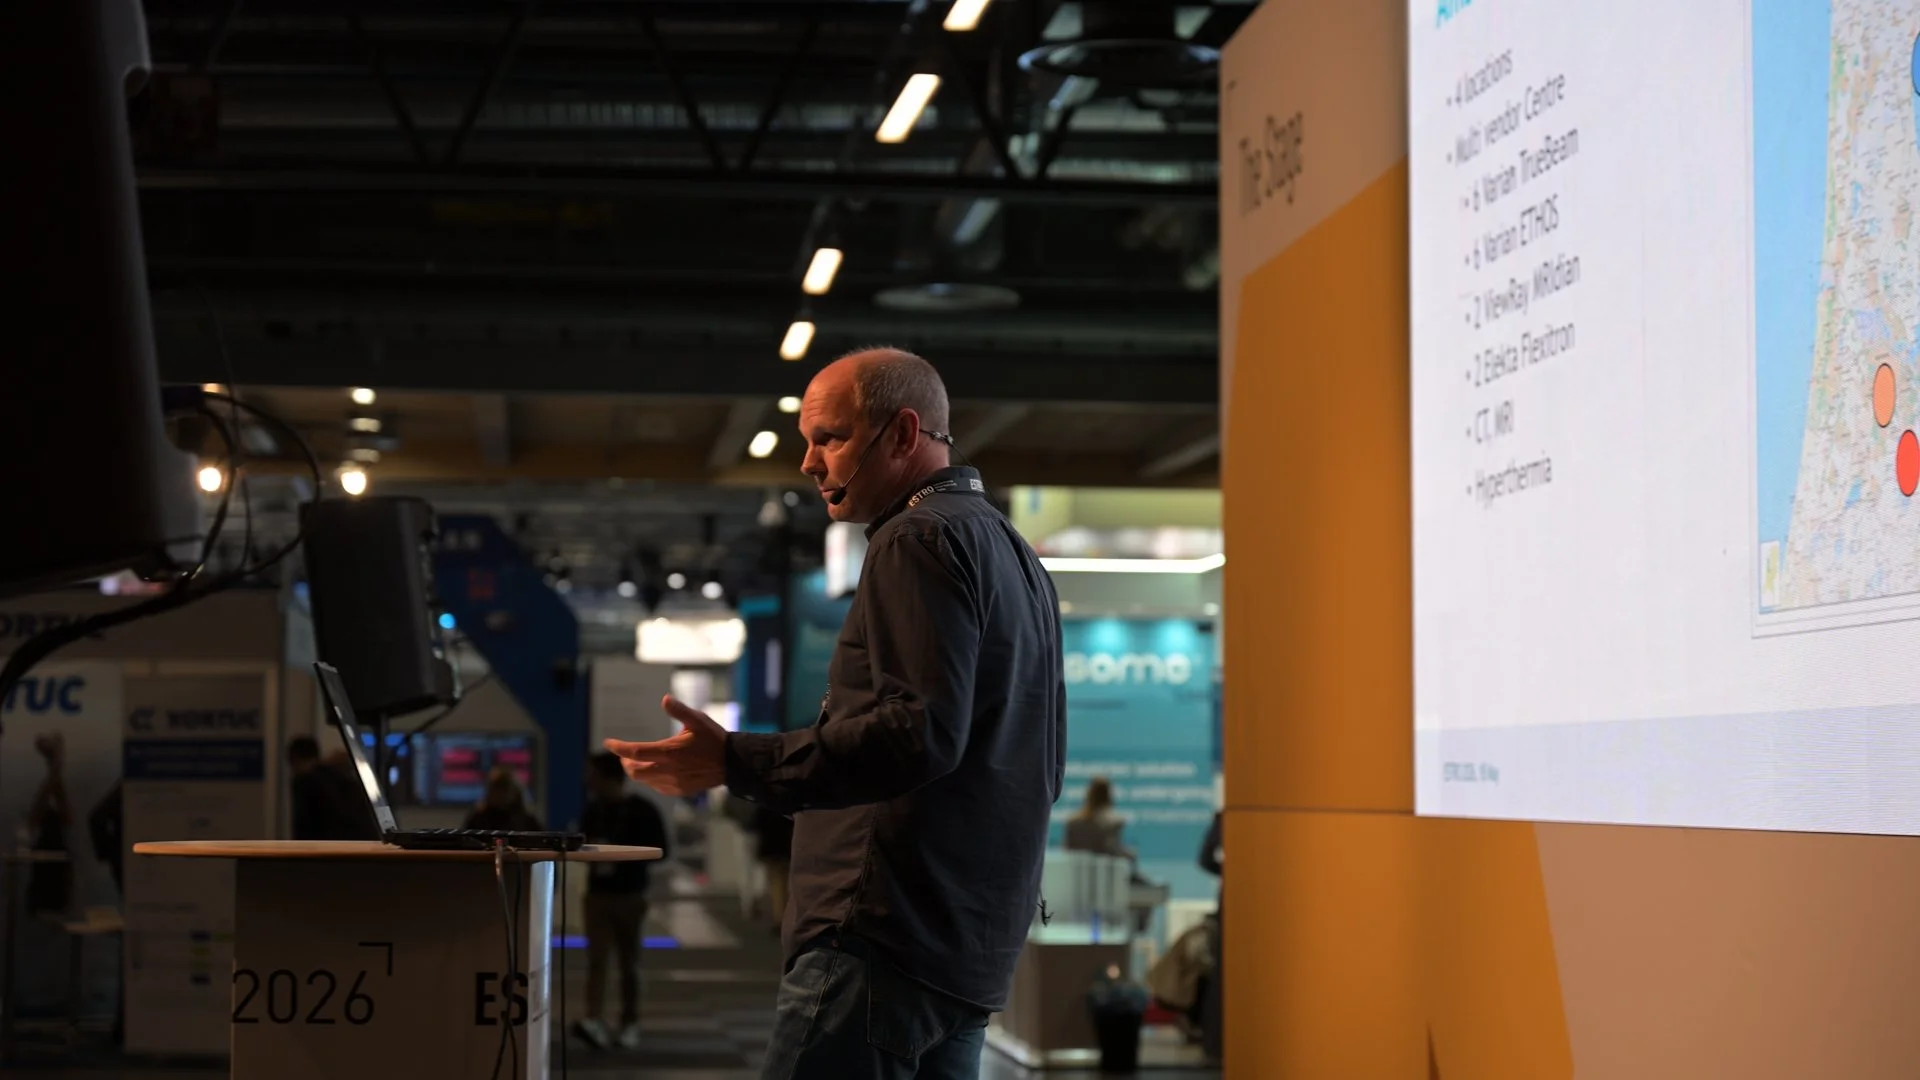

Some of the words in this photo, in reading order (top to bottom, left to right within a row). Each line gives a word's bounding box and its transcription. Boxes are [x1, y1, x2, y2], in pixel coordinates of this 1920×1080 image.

[1455, 79, 1462, 108] 4
[1464, 48, 1512, 103] locations
[1455, 121, 1481, 167] Multi
[1484, 100, 1522, 147] vendor
[1525, 73, 1565, 121] Centre
[1239, 135, 1262, 219] The
[1264, 112, 1304, 207] Stage
[1473, 178, 1480, 212] 6
[1482, 164, 1517, 205] Varian
[1519, 127, 1579, 184] TrueBeam
[1482, 223, 1517, 264] Varian
[1520, 193, 1559, 246] ETHOS
[1474, 295, 1481, 330] 2
[1484, 276, 1530, 323] ViewRay
[1475, 352, 1481, 388] 2
[1485, 344, 1518, 383] Elekta
[1521, 322, 1575, 369] Flexitron
[1495, 398, 1513, 436] MRI
[907, 485, 935, 508] ESTRO
[1475, 449, 1551, 509] Hyperthermia
[232, 969, 374, 1025] 2026
